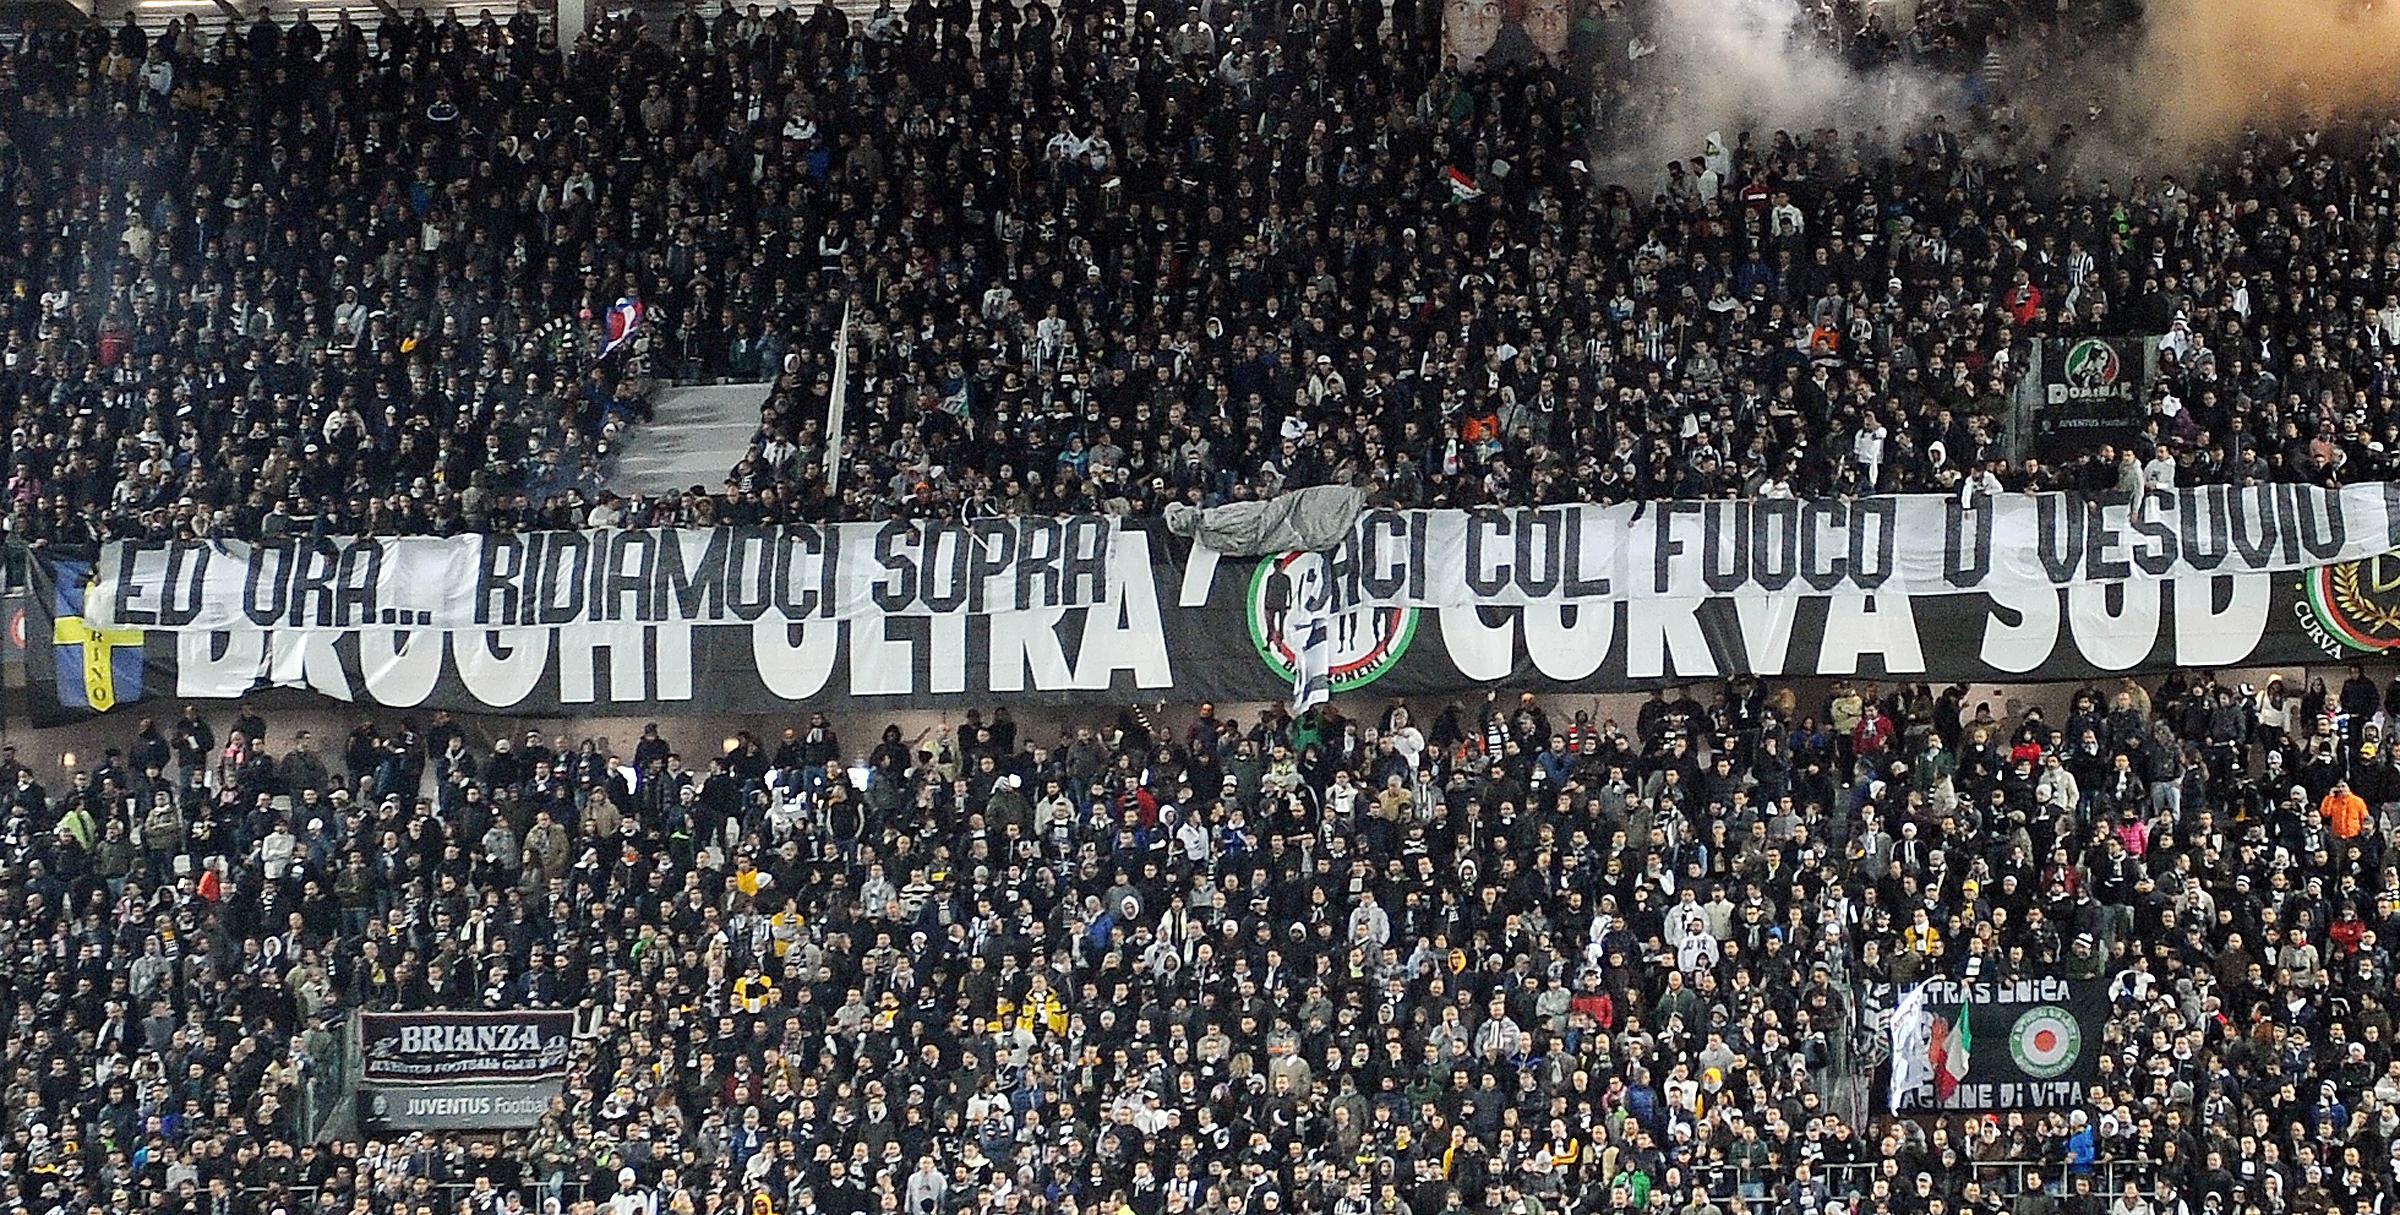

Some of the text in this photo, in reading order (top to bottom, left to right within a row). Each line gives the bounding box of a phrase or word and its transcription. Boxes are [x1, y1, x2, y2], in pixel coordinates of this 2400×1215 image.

[115, 538, 208, 626] ED
[474, 523, 841, 626] RIDIAMOCI
[871, 515, 1108, 615] SOPRA
[1464, 505, 1611, 599] COL
[1653, 499, 1896, 592] FUOCO
[2294, 600, 2343, 660] CURVA
[91, 630, 107, 701] RINO
[400, 1025, 541, 1053] BRIANZA
[406, 1097, 491, 1116] JUVENTUS
